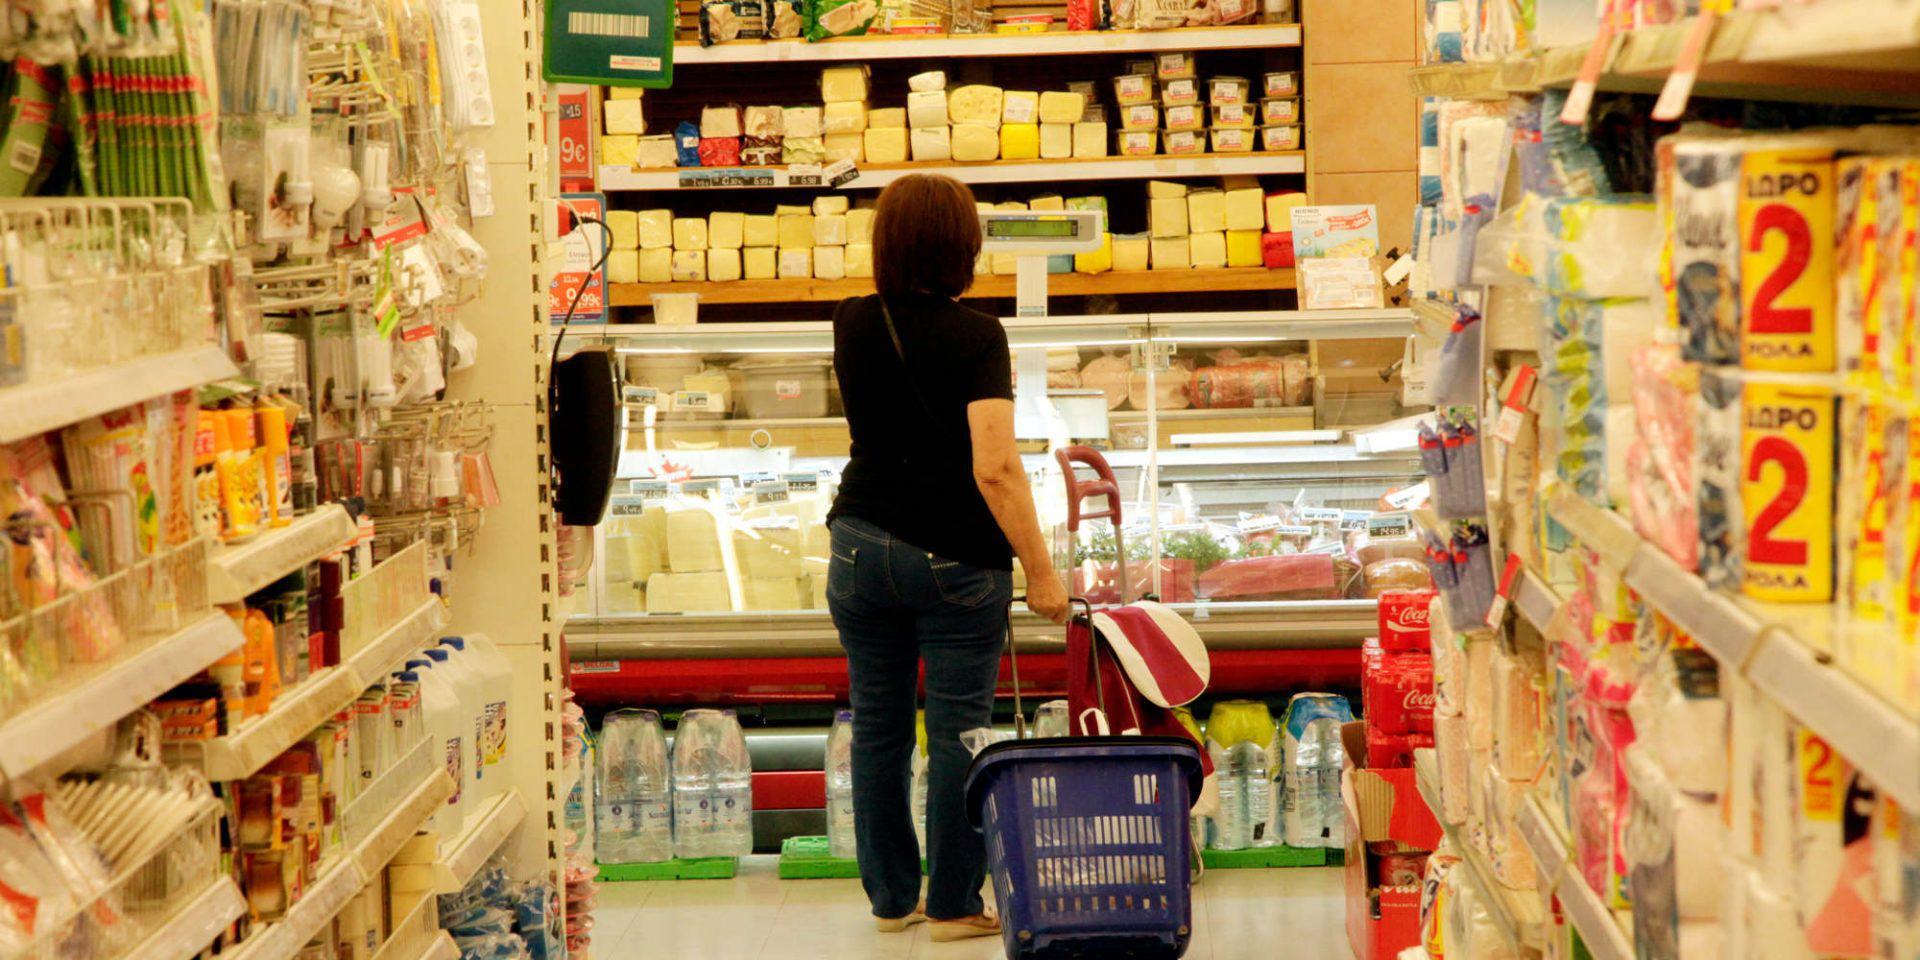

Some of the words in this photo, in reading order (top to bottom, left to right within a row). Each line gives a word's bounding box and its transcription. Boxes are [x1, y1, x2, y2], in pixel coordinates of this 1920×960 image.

[1747, 202, 1814, 334] 2
[1747, 434, 1810, 566] 2
[1804, 737, 1834, 787] 2
